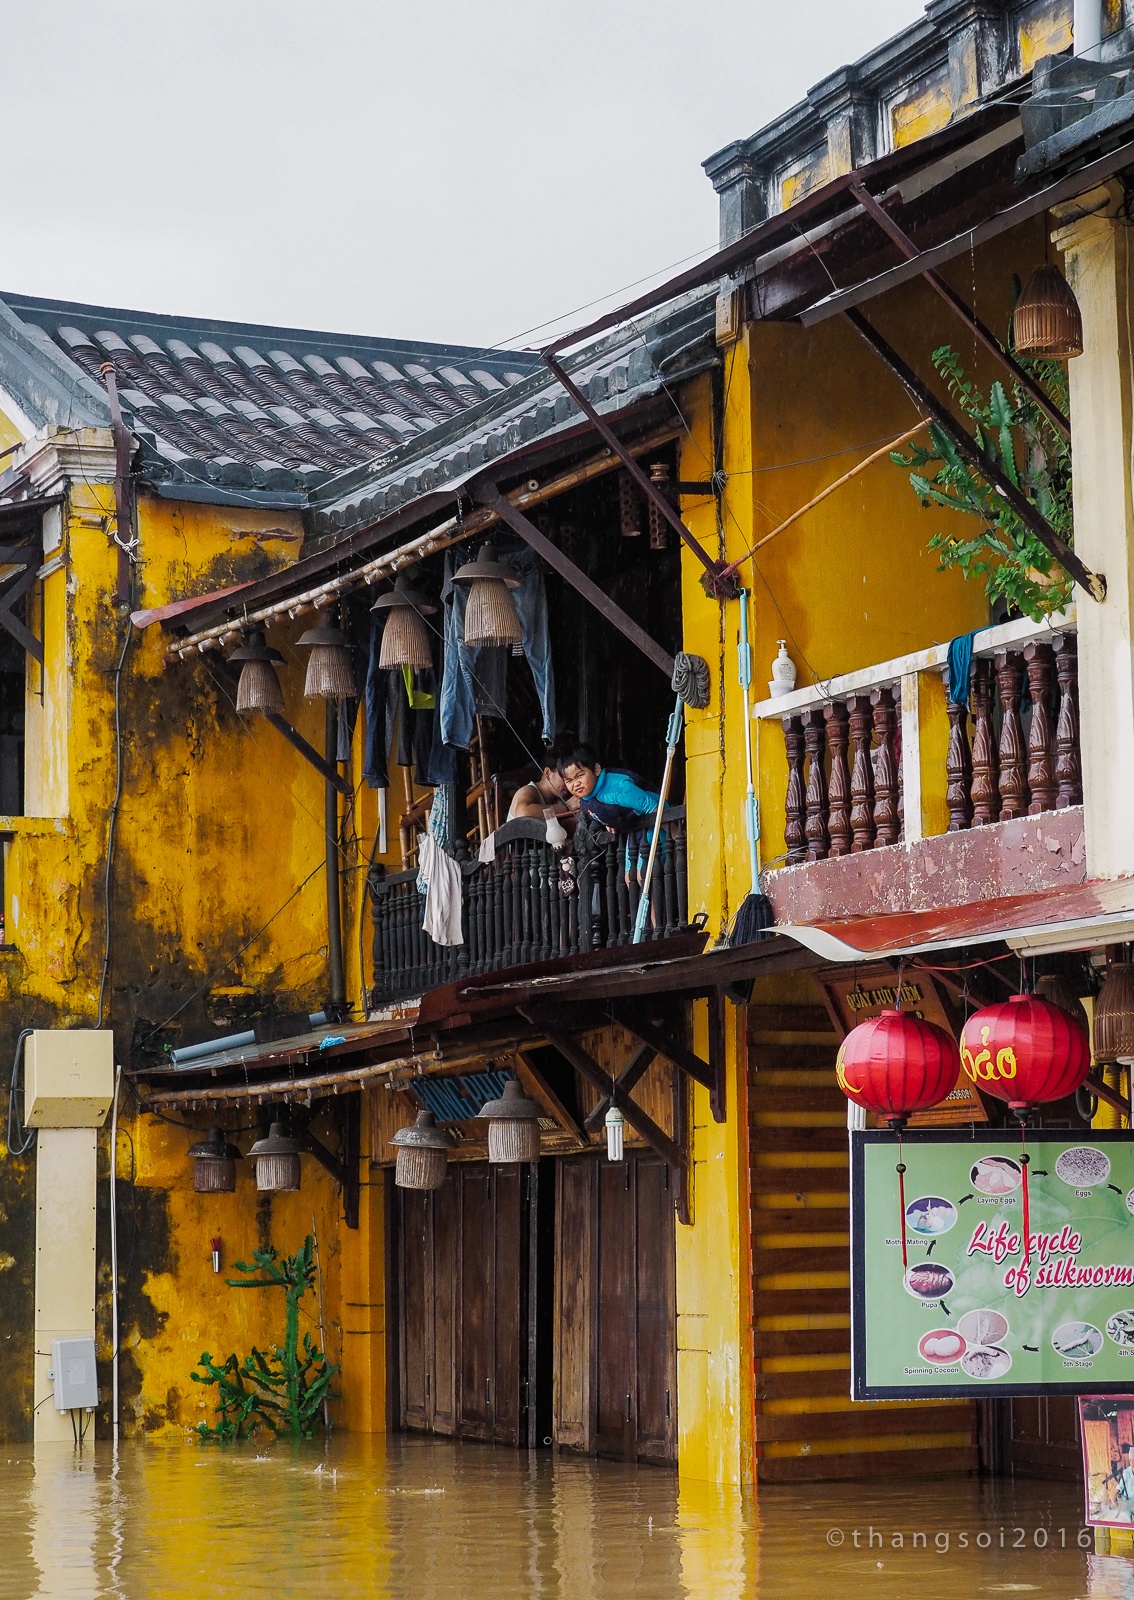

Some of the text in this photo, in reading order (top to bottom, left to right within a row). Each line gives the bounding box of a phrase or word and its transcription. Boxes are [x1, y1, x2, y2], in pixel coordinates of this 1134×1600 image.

[1075, 1189, 1092, 1197] Eggs
[1000, 1196, 1016, 1204] Eggs
[906, 1239, 928, 1247] Mating
[967, 1221, 1081, 1264] Life cycle
[1004, 1254, 1134, 1297] of silkworm
